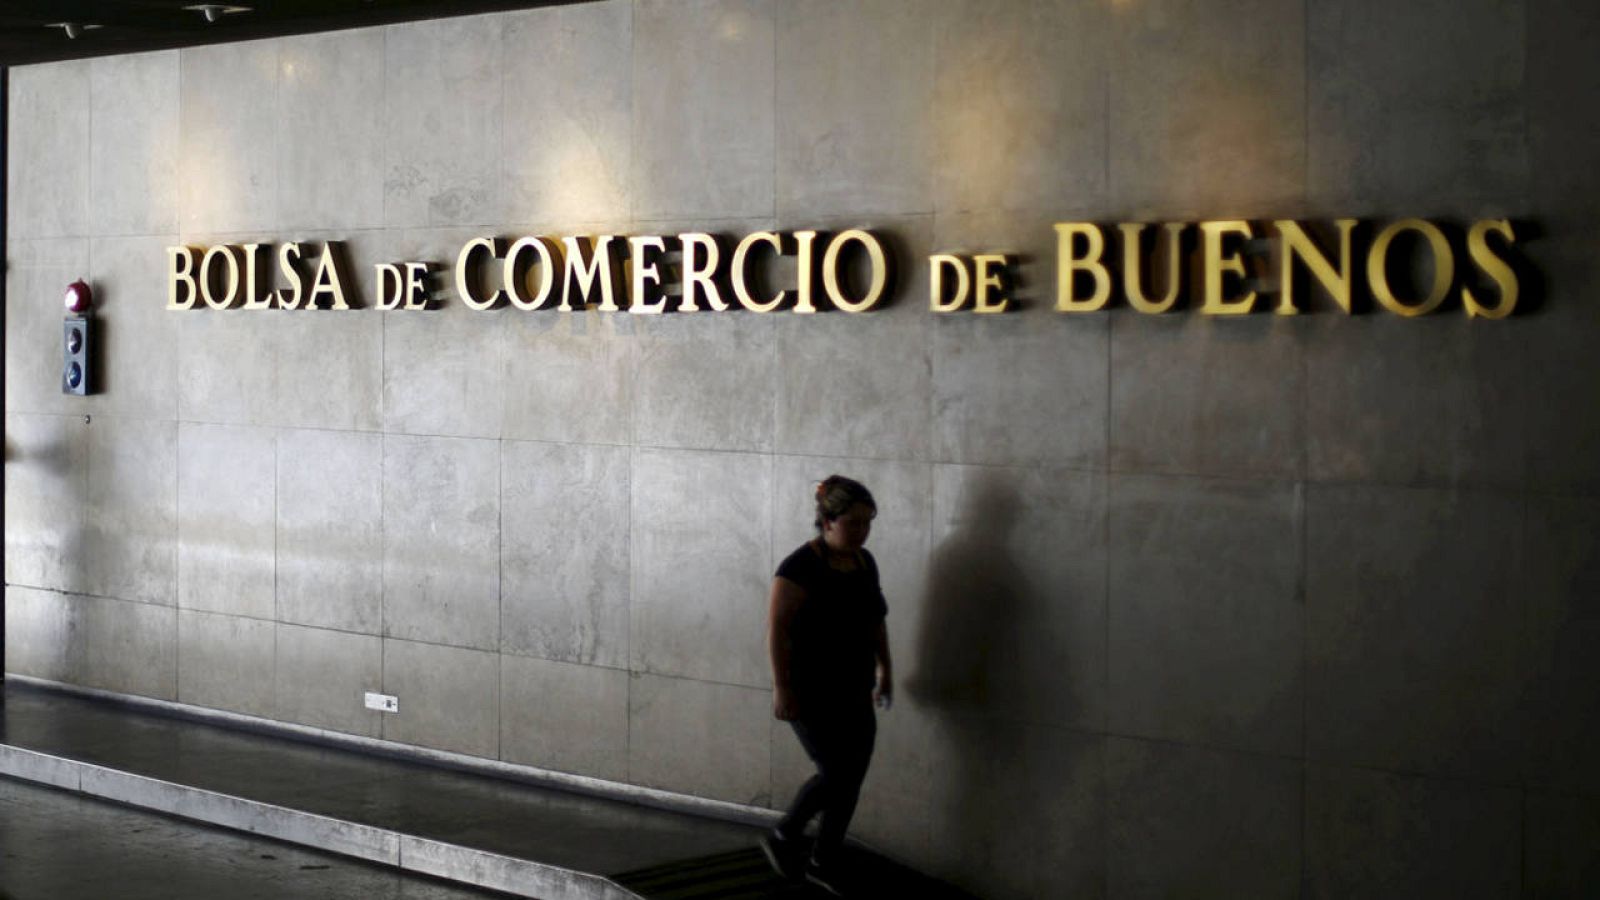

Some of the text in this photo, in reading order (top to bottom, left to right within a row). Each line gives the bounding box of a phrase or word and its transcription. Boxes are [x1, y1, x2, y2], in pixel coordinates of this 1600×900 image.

[166, 218, 1519, 320] BOLSA DE COMERCIO DE BUENOS
